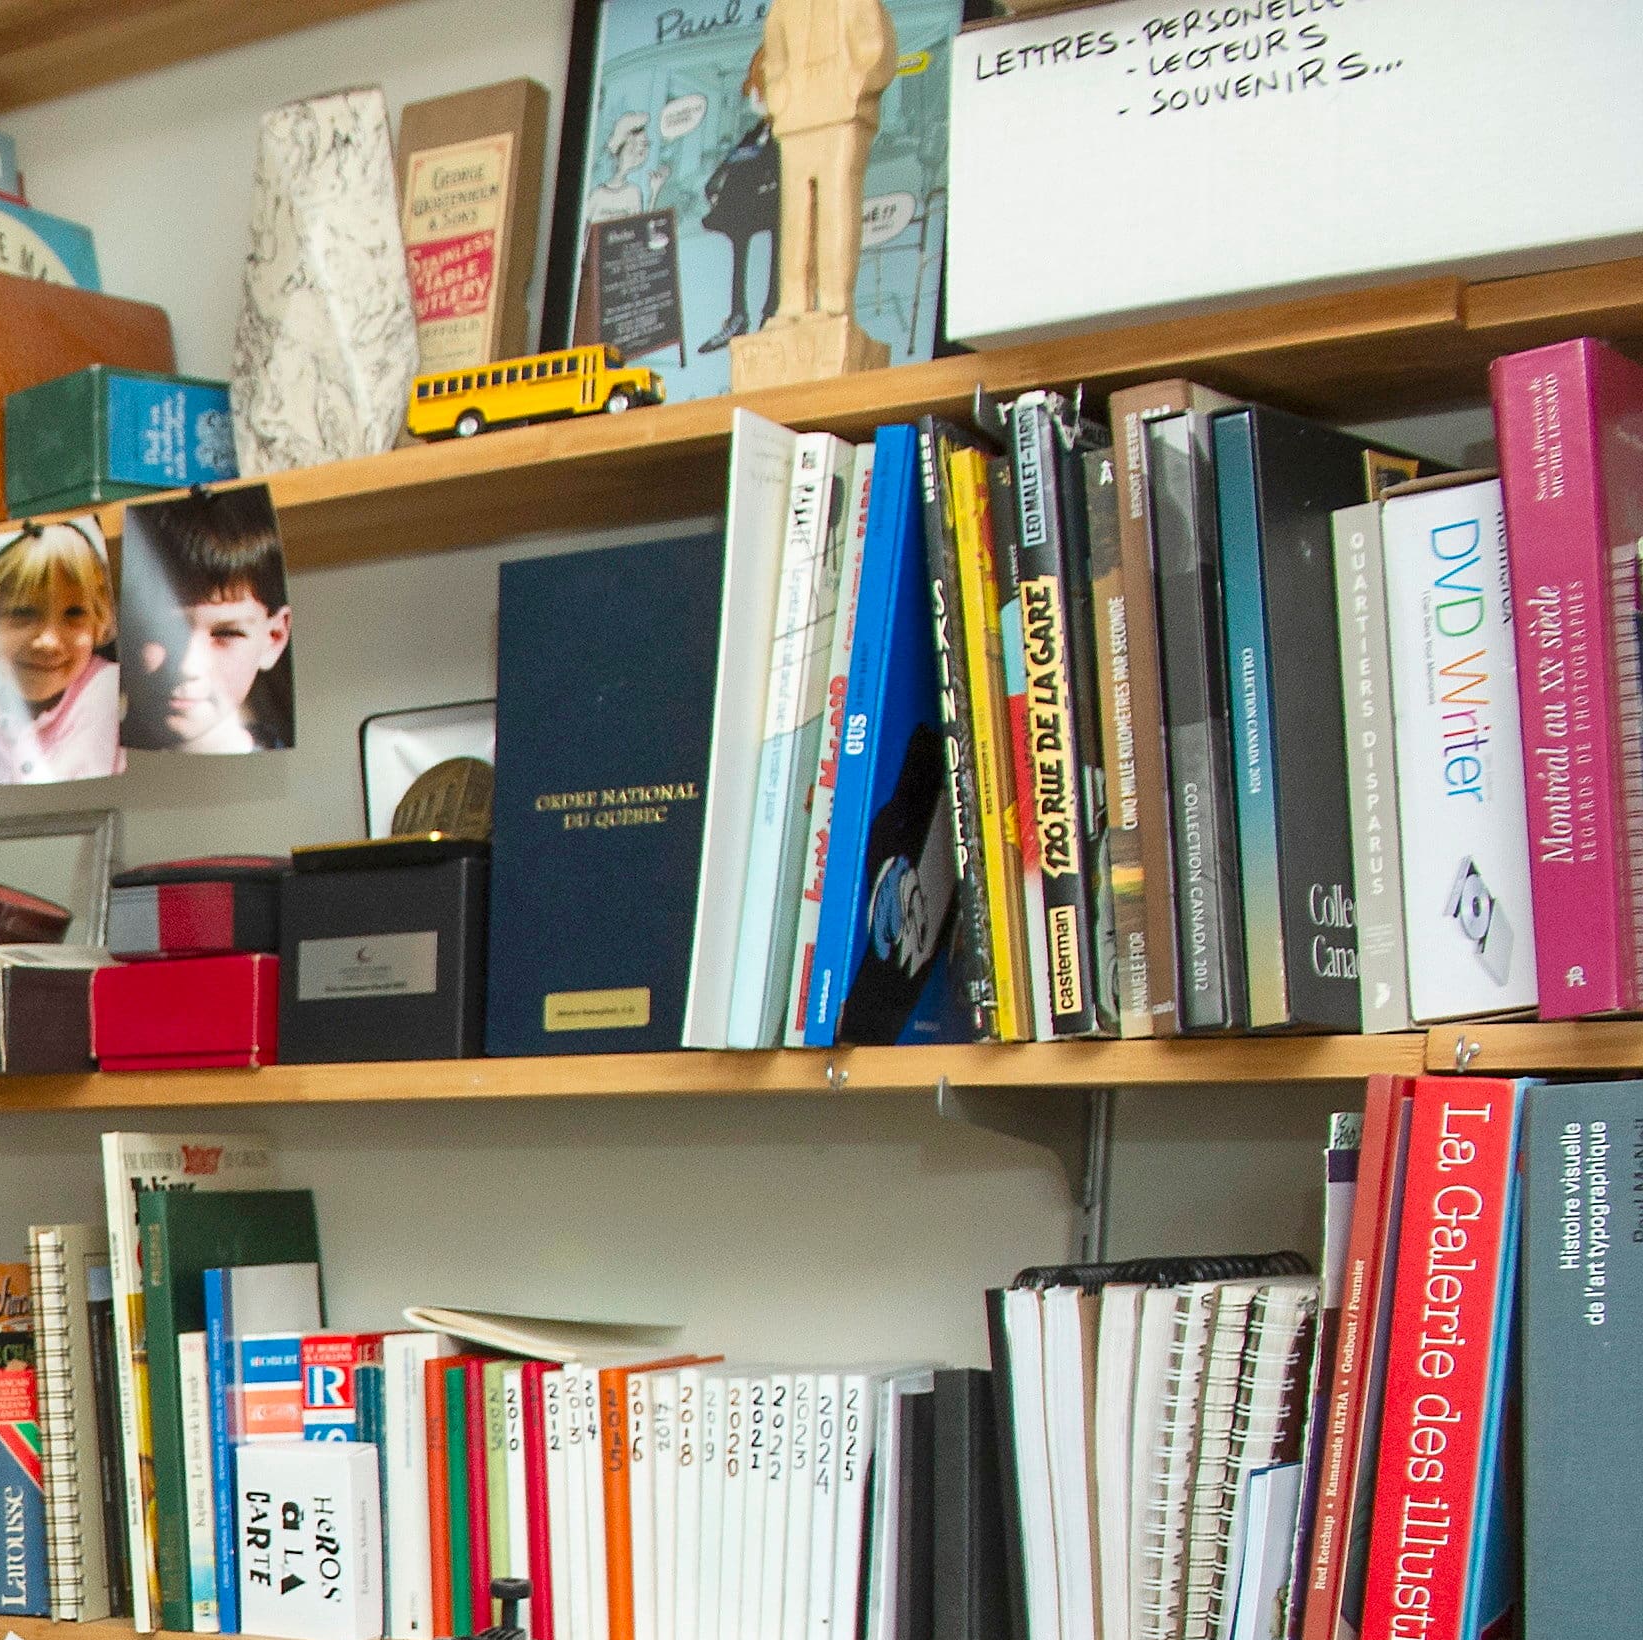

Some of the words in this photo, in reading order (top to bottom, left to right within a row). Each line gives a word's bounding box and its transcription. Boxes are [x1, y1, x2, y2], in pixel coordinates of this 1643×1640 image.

[656, 0, 742, 44] Paul
[1148, 22, 1330, 77] LECTEURS
[976, 30, 1118, 81] LETTRES
[432, 163, 484, 189] GEORGE
[1533, 396, 1547, 456] direction
[1544, 371, 1562, 443] LESSARD
[1536, 470, 1550, 502] Sous
[1550, 445, 1566, 501] MICHEL
[1430, 518, 1486, 638] DVD
[1025, 584, 1056, 668] GARE
[1107, 595, 1127, 654] SECONDE
[1526, 584, 1564, 650] siècle
[1034, 670, 1057, 706] LA
[1241, 647, 1256, 720] COLLECTION
[1570, 579, 1594, 734] PHOTOGRAPHES
[844, 712, 868, 756] GUS
[1035, 711, 1061, 754] DE
[1245, 719, 1259, 766] CANADA
[1349, 531, 1375, 719] QUARTIERS
[1362, 731, 1384, 896] DISPARUS
[1439, 648, 1492, 803] Writer
[1543, 700, 1568, 738] au
[1119, 760, 1137, 797] MILLE
[1248, 766, 1261, 794] 2024
[1577, 739, 1594, 767] DE
[535, 790, 597, 812] ORDRE
[601, 781, 699, 807] NATIONAL
[1040, 757, 1066, 814] RUE
[1120, 797, 1139, 831] CINQ
[1535, 745, 1575, 865] Montréal
[1579, 772, 1599, 863] REGARDS
[563, 811, 591, 831] DU
[1182, 782, 1203, 883] COLLECTION
[1189, 886, 1206, 956] CANADA
[1309, 883, 1358, 929] Colle
[1055, 907, 1077, 1014] casterman
[1194, 958, 1209, 992] 2012
[1312, 934, 1360, 979] Cana
[1436, 1101, 1493, 1172] La
[1561, 1120, 1582, 1190] visuelle
[1585, 1119, 1609, 1255] typographique
[1559, 1192, 1581, 1272] Histoire
[1350, 1258, 1366, 1308] Fournier
[1414, 1183, 1486, 1381] Galerie
[1584, 1298, 1605, 1327] de
[1341, 1319, 1355, 1374] Godbout
[307, 1364, 346, 1405] R
[546, 1382, 563, 1451] 2012
[565, 1375, 582, 1445] 2013
[583, 1379, 599, 1441] 2014
[1335, 1390, 1349, 1433] ULTRA
[506, 1388, 519, 1452] 2010
[605, 1388, 624, 1473] 2015
[629, 1379, 645, 1463] 2016
[652, 1400, 673, 1452] 2017
[678, 1385, 694, 1467] 2018
[703, 1391, 717, 1463] 2019
[726, 1387, 741, 1478] 2020
[750, 1385, 765, 1470] 2021
[769, 1385, 788, 1480] 2022
[793, 1382, 809, 1470] 2023
[814, 1395, 834, 1496] 2024
[842, 1388, 860, 1483] 2025
[1406, 1388, 1463, 1485] des
[1326, 1435, 1344, 1499] Kamarade
[1, 1486, 27, 1608] Larousse
[245, 1490, 272, 1588] CARTE
[1318, 1513, 1336, 1566] Ketchup
[280, 1549, 306, 1596] LA
[1315, 1566, 1328, 1592] Red
